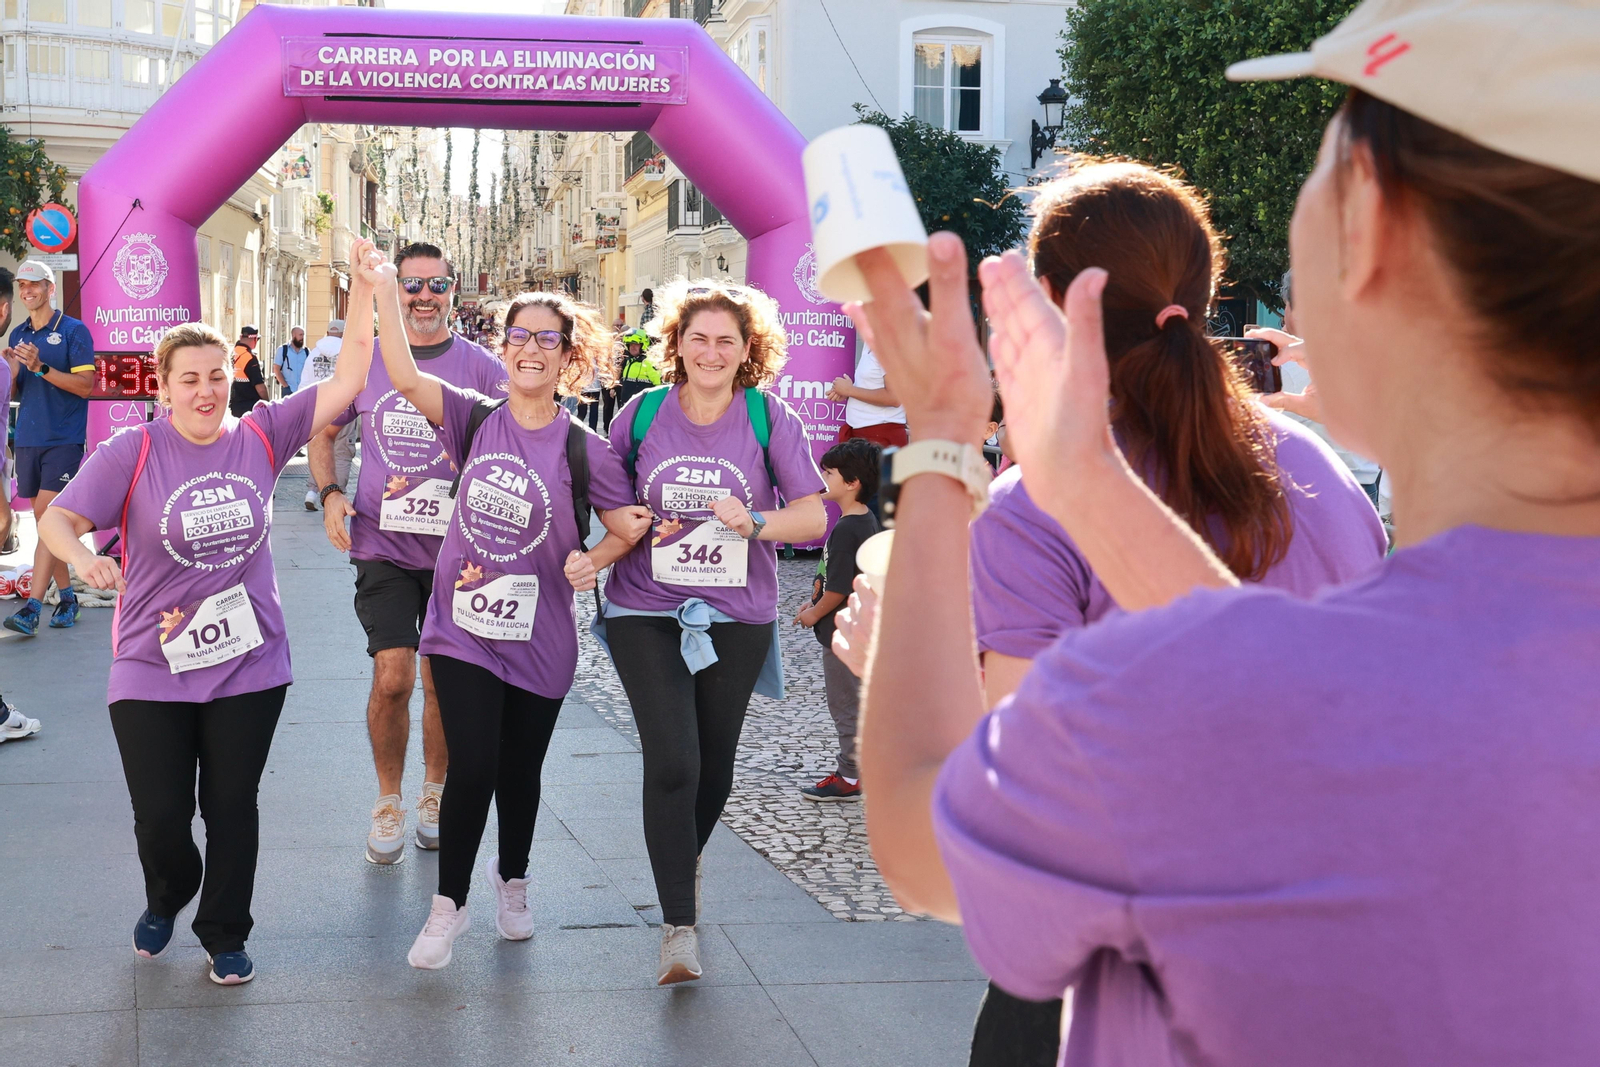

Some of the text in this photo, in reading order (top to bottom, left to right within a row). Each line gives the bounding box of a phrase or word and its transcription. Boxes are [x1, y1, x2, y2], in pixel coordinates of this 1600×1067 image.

[318, 46, 655, 71] CARRERA POR LA ELIMINACIÓN
[300, 70, 671, 93] DE LA VIOLENCIA CONTRA LAS MUJERES
[94, 304, 190, 327] Ayuntamiento
[777, 309, 855, 330] yuntamiento
[109, 326, 169, 345] de Cádi
[786, 329, 846, 348] de Cádiz
[108, 400, 170, 422] CÁDI
[394, 396, 421, 414] 25
[384, 426, 401, 434] 900
[402, 427, 411, 435] 21
[421, 430, 433, 438] 30
[390, 418, 429, 429] 24 HORAS
[815, 433, 835, 443] Mujer
[225, 472, 258, 492] CONTRA
[485, 465, 529, 496] 25N
[642, 455, 753, 500] DÍA INTERNACIONAL CONTRA LA
[675, 466, 721, 486] 25N
[163, 471, 224, 515] INTERNACIONAL
[189, 484, 236, 507] 25N
[527, 469, 551, 507] CONTRA
[672, 492, 719, 502] 24 HORAS
[694, 488, 728, 496] EMERGENCIAS
[183, 509, 206, 518] SERVICIO
[212, 501, 247, 512] EMERGENCIAS
[402, 497, 440, 517] 325
[469, 497, 525, 525] 900 21 21 30
[477, 489, 520, 514] 24 HORAS
[665, 501, 687, 510] 900
[688, 501, 698, 509] 21
[192, 508, 241, 526] 24 HORAS
[393, 514, 415, 523] AMOR
[426, 518, 450, 526] LASTIM
[545, 507, 553, 520] LA
[158, 516, 169, 535] DÍA
[187, 516, 249, 538] 900 21 21 30
[519, 520, 551, 556] VIOLENCIA
[161, 539, 194, 568] UJERES
[489, 552, 518, 563] HACIA
[676, 543, 723, 565] 346
[194, 560, 213, 572] LAS
[699, 566, 727, 574] MENOS
[215, 591, 243, 607] CARRERA
[470, 592, 519, 620] 042
[456, 607, 465, 615] TU
[465, 610, 485, 624] LUCHA
[486, 618, 495, 626] ES
[495, 620, 506, 628] MI
[506, 621, 530, 629] LUCHA
[188, 617, 231, 650] 101
[196, 647, 214, 658] UNA
[214, 635, 242, 652] MENOS
